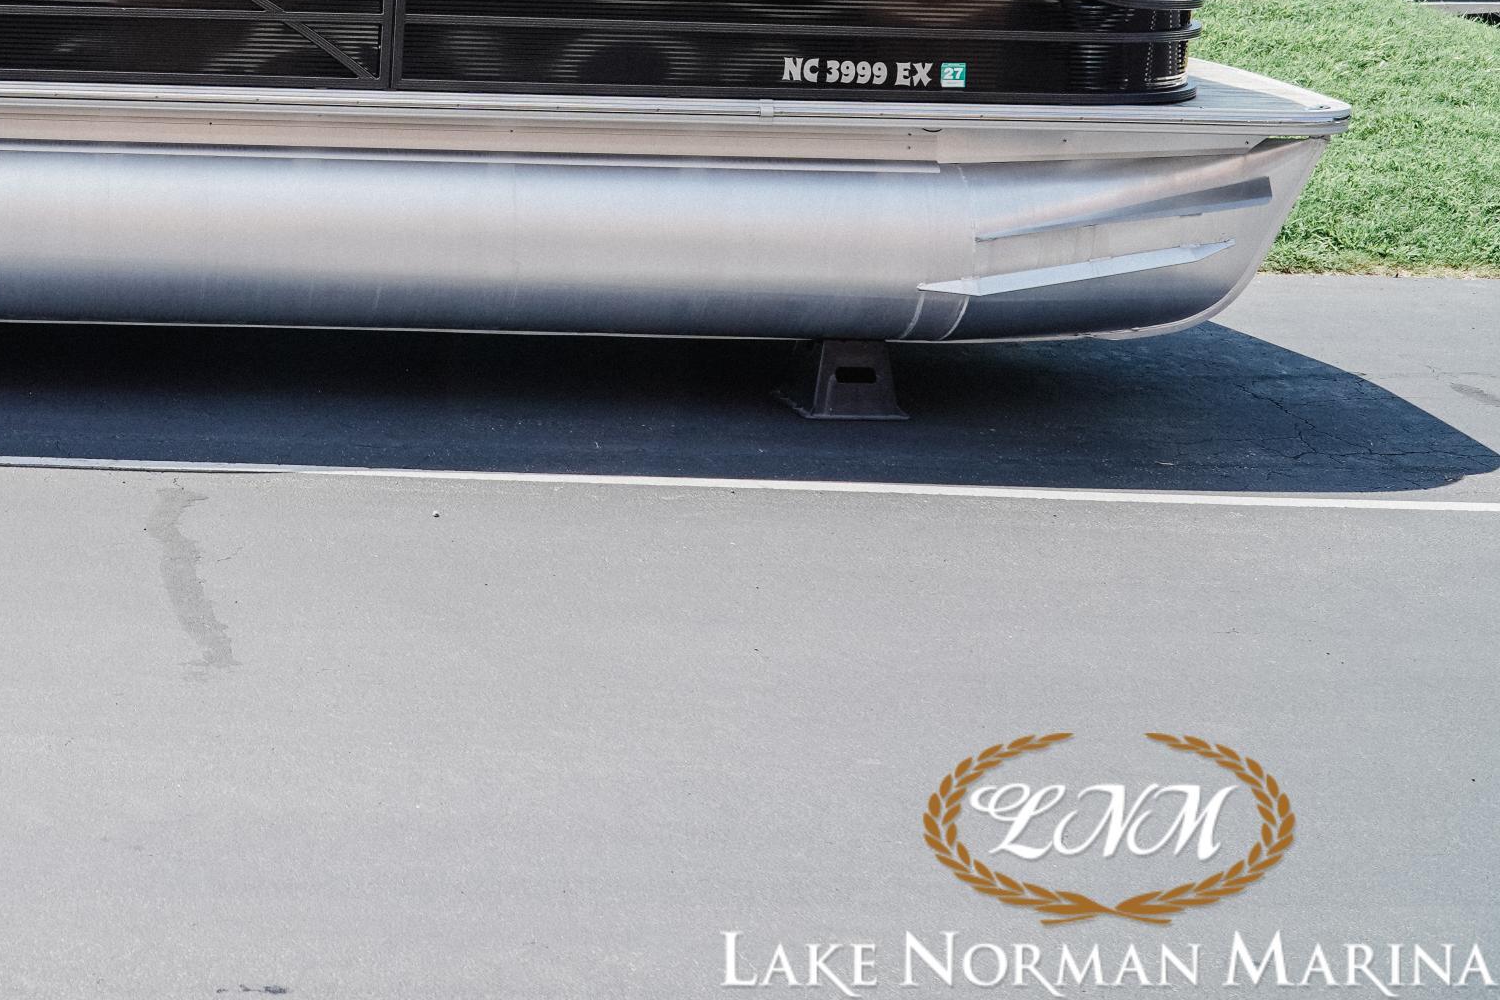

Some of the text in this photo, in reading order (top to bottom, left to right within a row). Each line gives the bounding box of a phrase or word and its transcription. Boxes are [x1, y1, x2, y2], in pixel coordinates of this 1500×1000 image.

[782, 57, 934, 87] NC 3999 EX
[943, 67, 964, 80] 27
